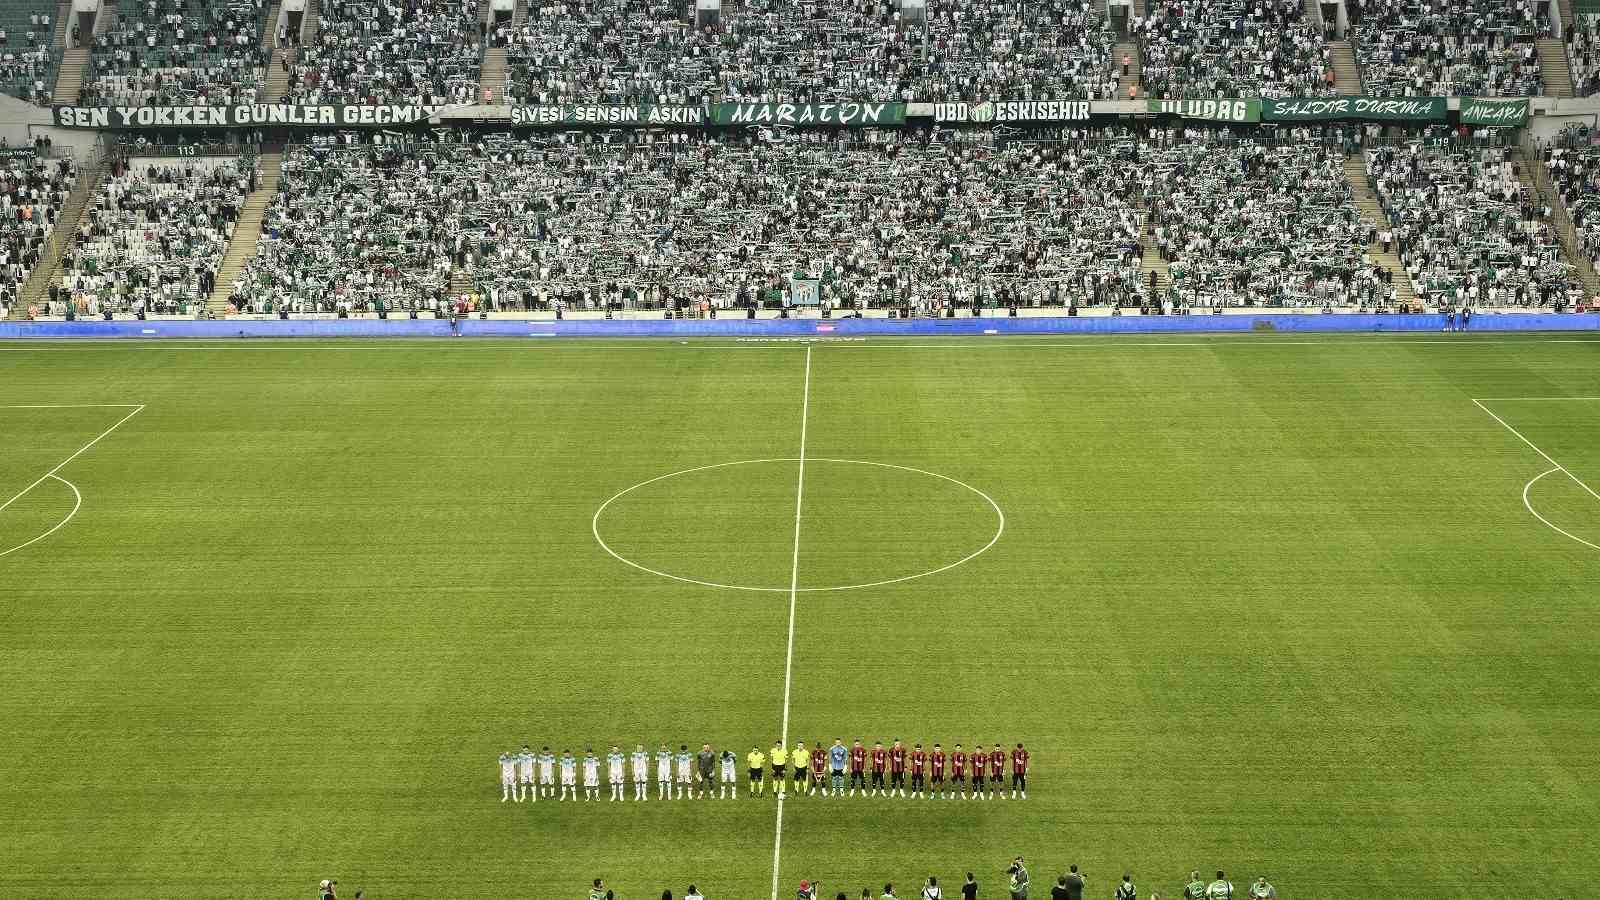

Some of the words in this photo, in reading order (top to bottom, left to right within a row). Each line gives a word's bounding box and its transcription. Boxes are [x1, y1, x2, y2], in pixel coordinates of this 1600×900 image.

[731, 103, 885, 124] MARATON
[1273, 99, 1351, 115] SALDIR
[1355, 99, 1433, 114] DURMA
[1462, 105, 1527, 122] ANKARA
[59, 106, 109, 126] SEN
[116, 106, 227, 126] YOKKEN
[177, 145, 195, 155] 113
